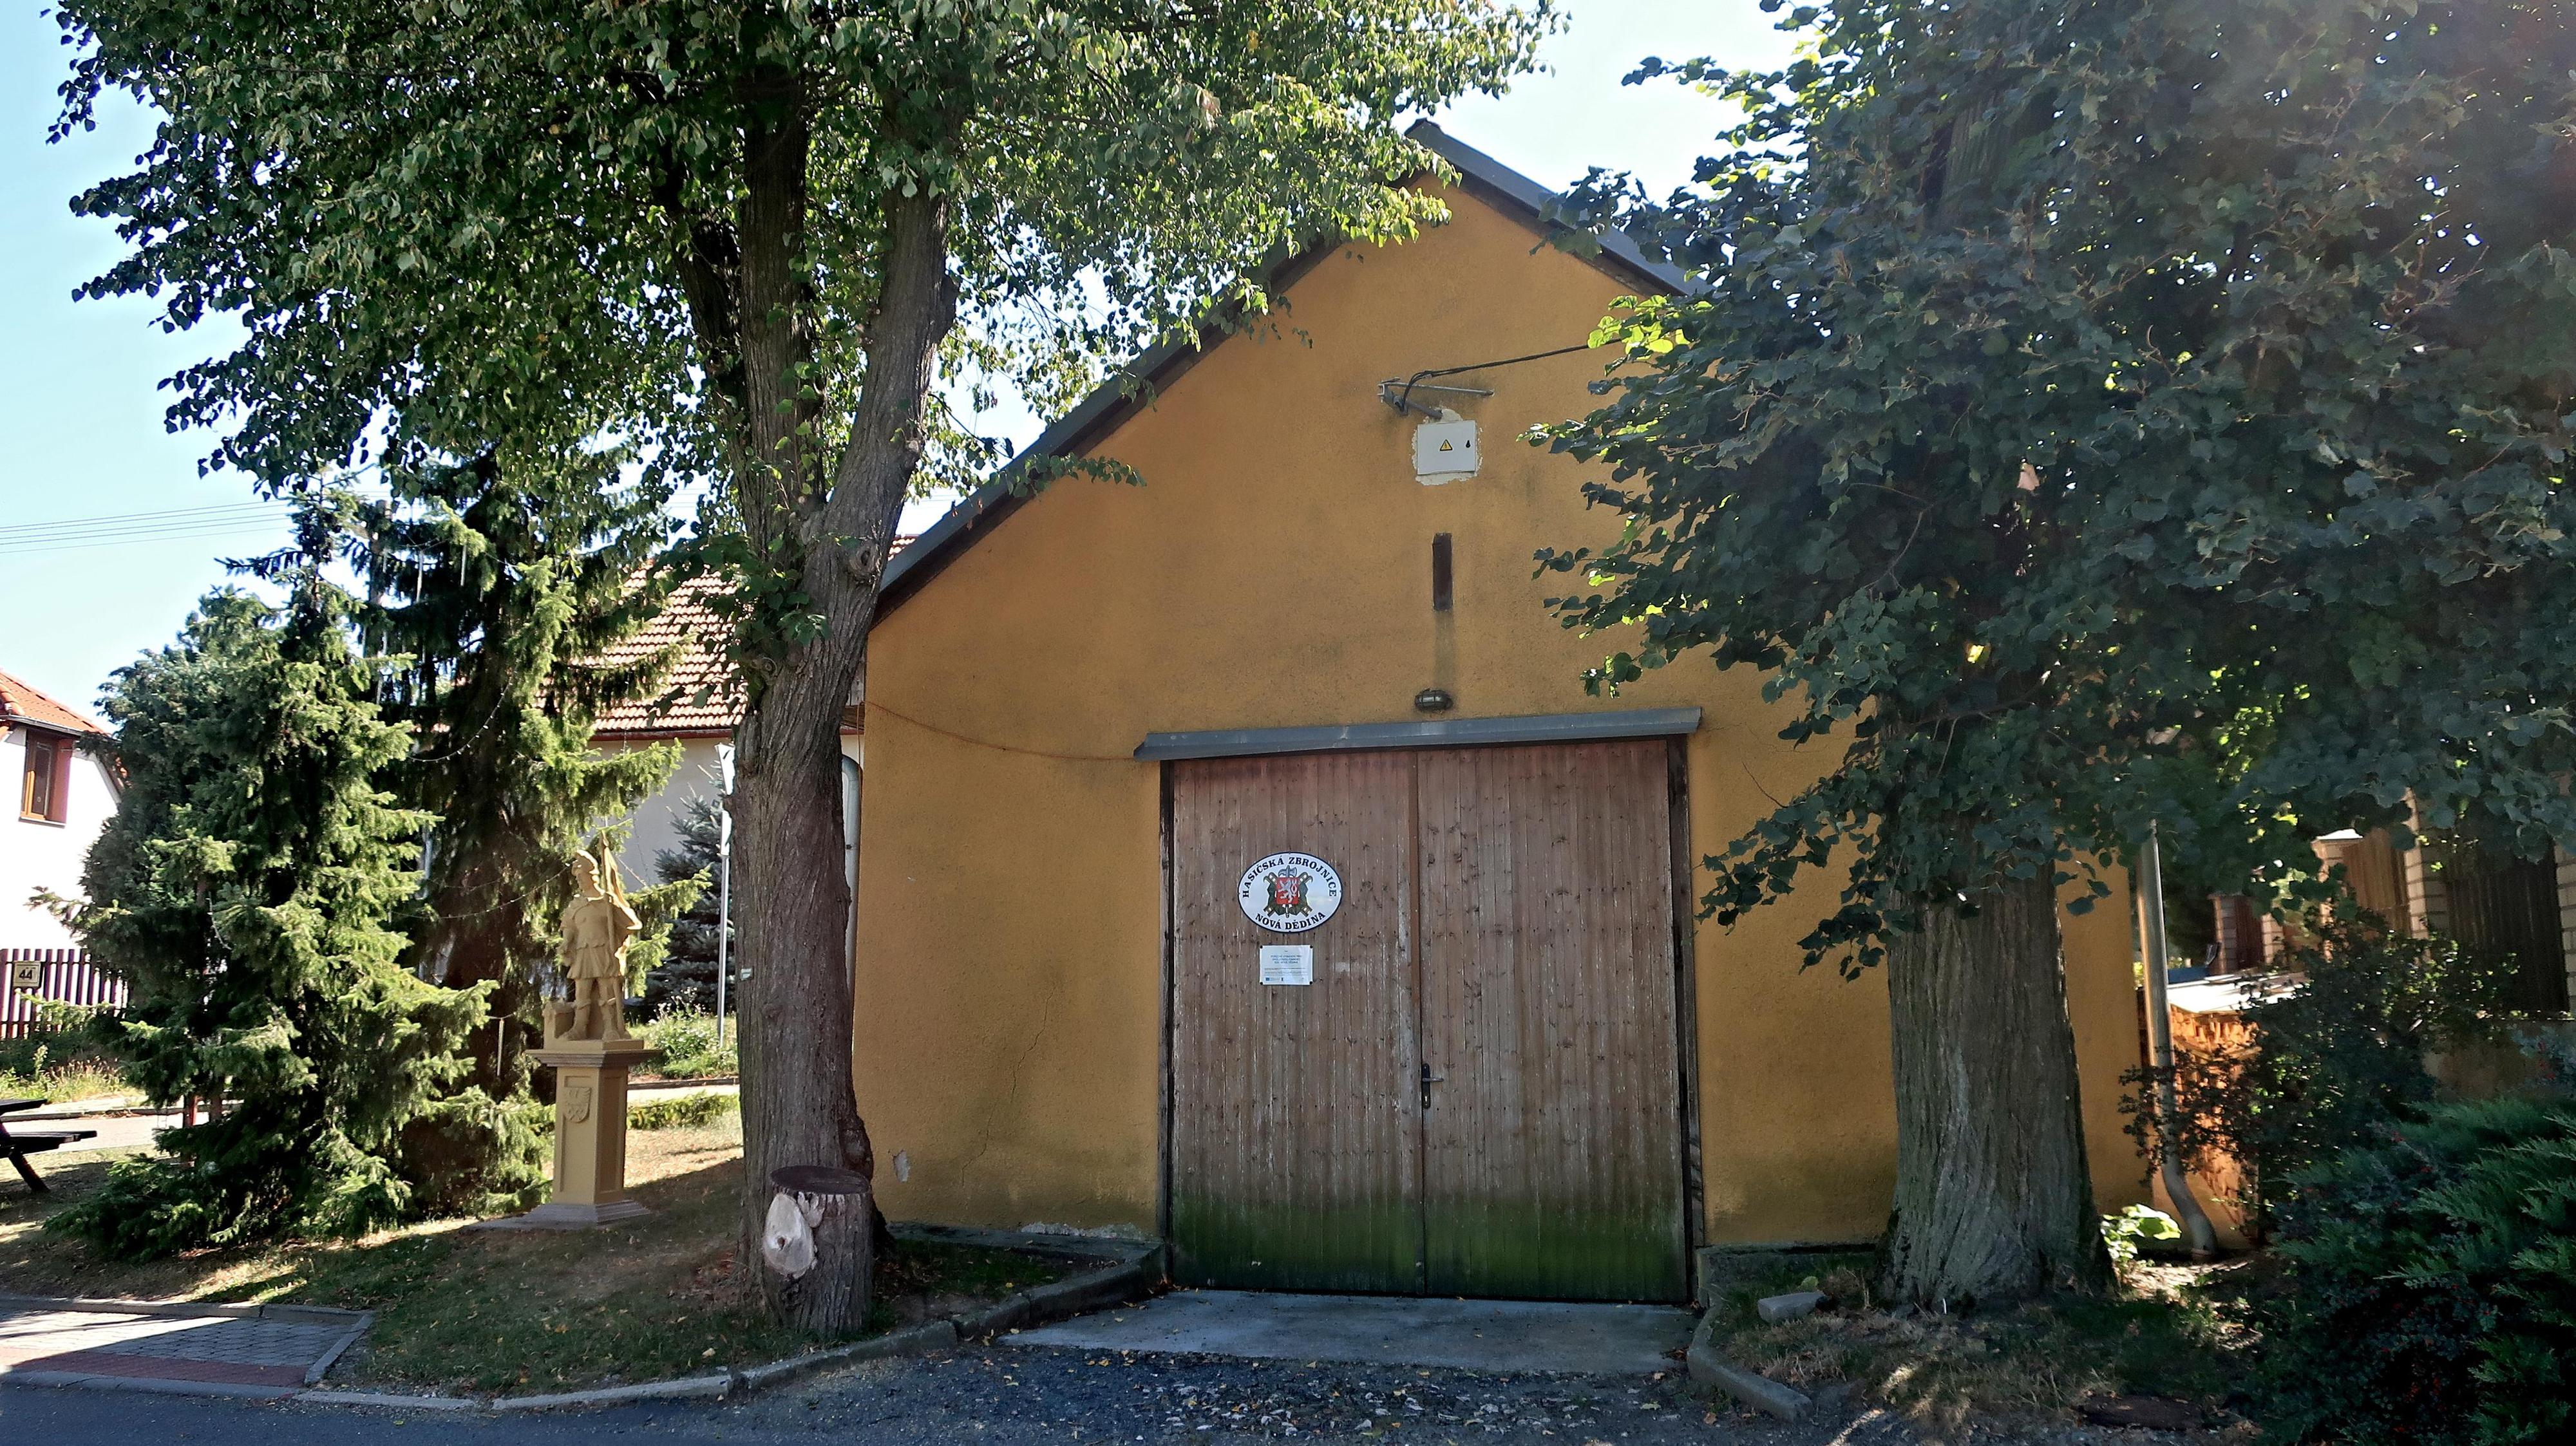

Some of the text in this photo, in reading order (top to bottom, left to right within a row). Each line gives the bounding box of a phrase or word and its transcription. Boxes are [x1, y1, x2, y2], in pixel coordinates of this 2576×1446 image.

[1243, 856, 1336, 897] HASIČSKÁ ZBROJNICE
[1255, 911, 1325, 929] NOVÁ DĚDINA
[19, 969, 32, 979] 44
